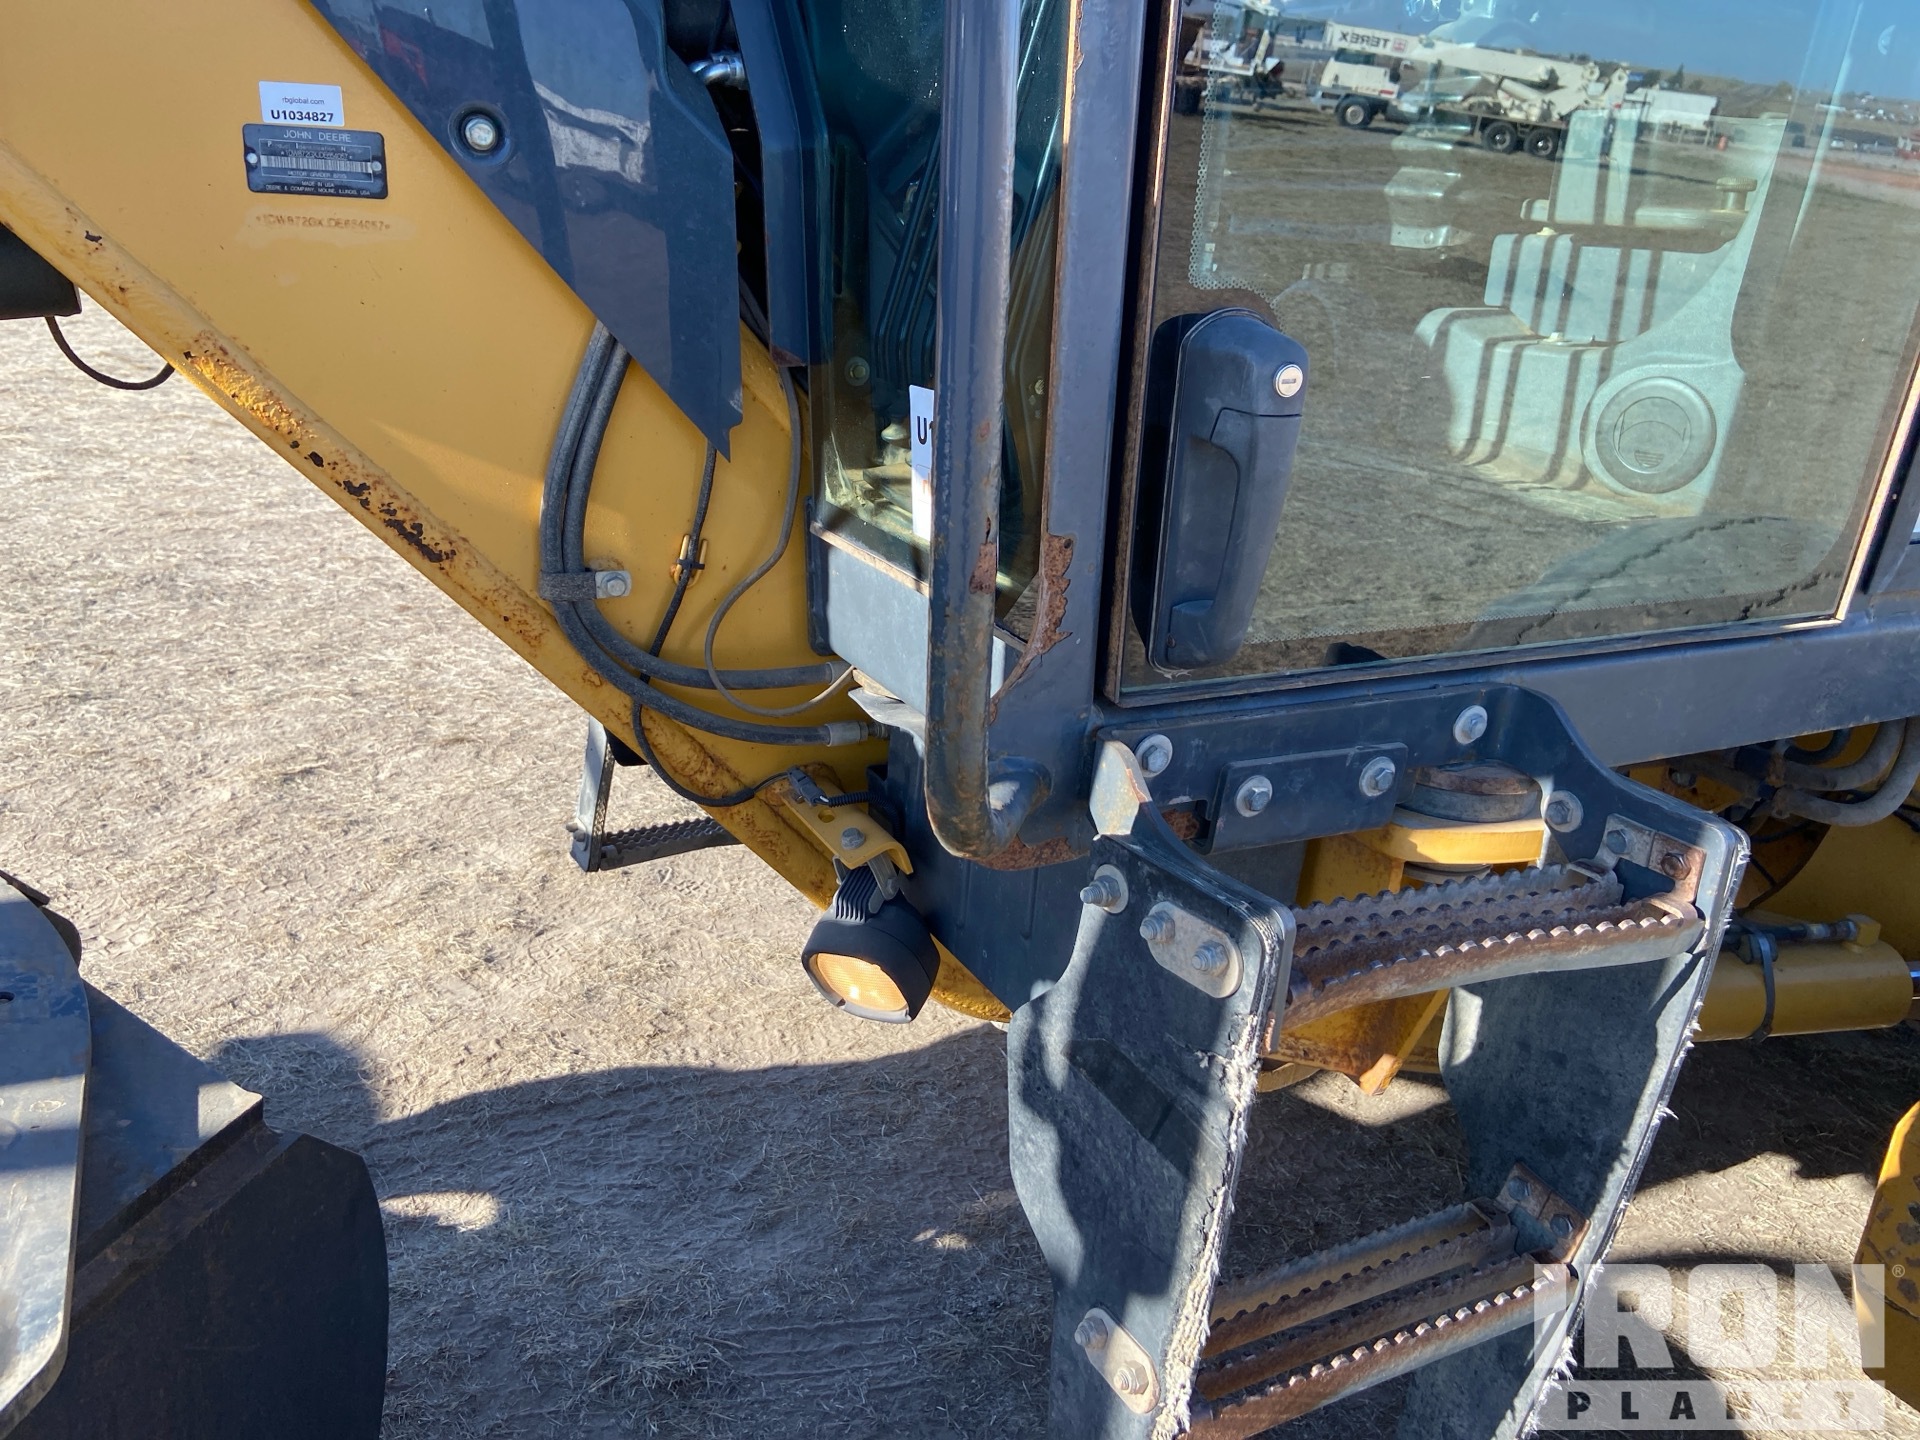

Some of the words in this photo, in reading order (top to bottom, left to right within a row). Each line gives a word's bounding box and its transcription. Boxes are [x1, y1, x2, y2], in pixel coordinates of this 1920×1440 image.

[282, 96, 325, 105] rbglobal.com
[270, 109, 334, 122] U1034827
[283, 129, 312, 140] JOHN
[318, 131, 352, 143] DEERE
